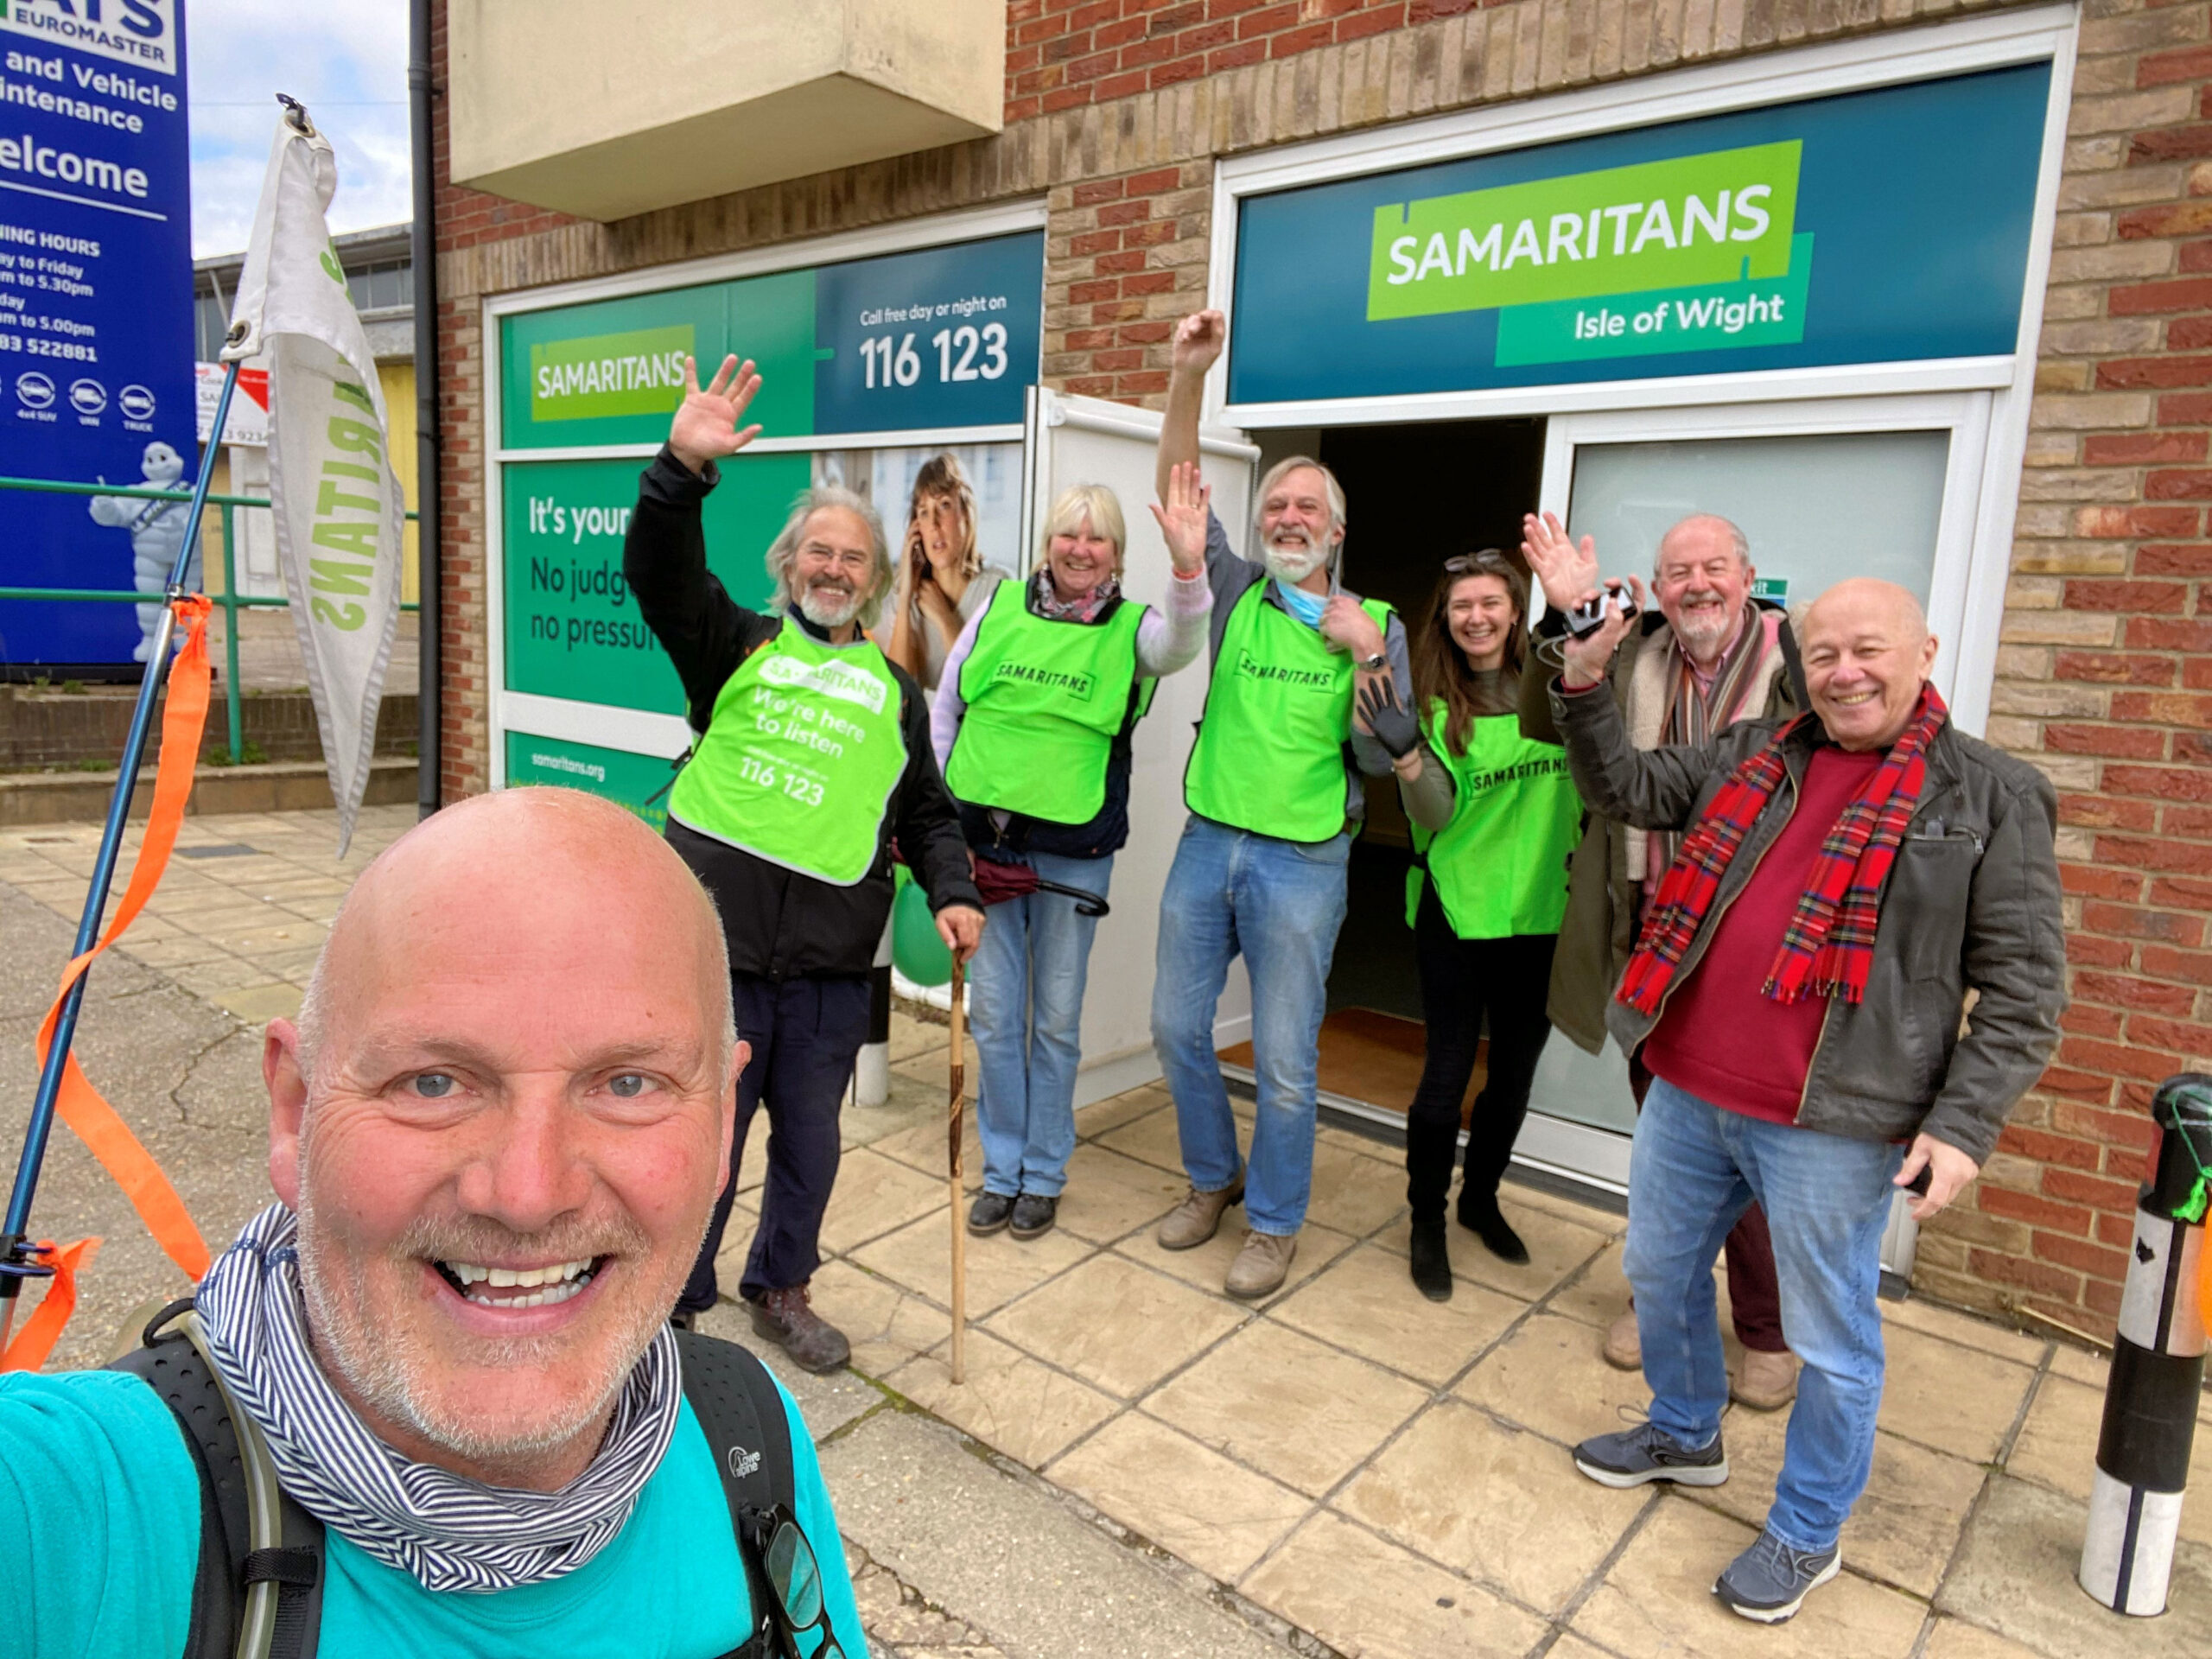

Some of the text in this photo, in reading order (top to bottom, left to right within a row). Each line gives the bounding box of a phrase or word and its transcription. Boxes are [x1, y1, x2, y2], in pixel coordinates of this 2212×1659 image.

[16, 8, 165, 63] EUROMASTER
[6, 51, 178, 111] and Vehicle
[0, 134, 149, 198] elcome
[40, 232, 101, 257] HOURS
[1386, 184, 1772, 285] SAMARITANS
[18, 255, 35, 270] to
[38, 257, 84, 281] Friday
[18, 272, 35, 287] to
[37, 274, 94, 297] 5.30pm
[20, 314, 37, 328] to
[39, 315, 95, 338] 5.00pm
[860, 296, 1007, 326] Call free day or night on
[1574, 293, 1786, 340] Isle of Wight
[27, 337, 98, 363] 522881
[859, 321, 1008, 389] 116 123
[537, 350, 685, 400] SAMARITANS
[529, 496, 631, 545] It's your
[531, 556, 628, 607] No judg
[531, 614, 560, 641] no
[996, 664, 1088, 693] SAMARITANS
[753, 684, 867, 744] We're here
[755, 713, 844, 760] to listen
[531, 753, 606, 783] samaritans.org
[740, 756, 776, 788] 116
[784, 773, 825, 807] 123
